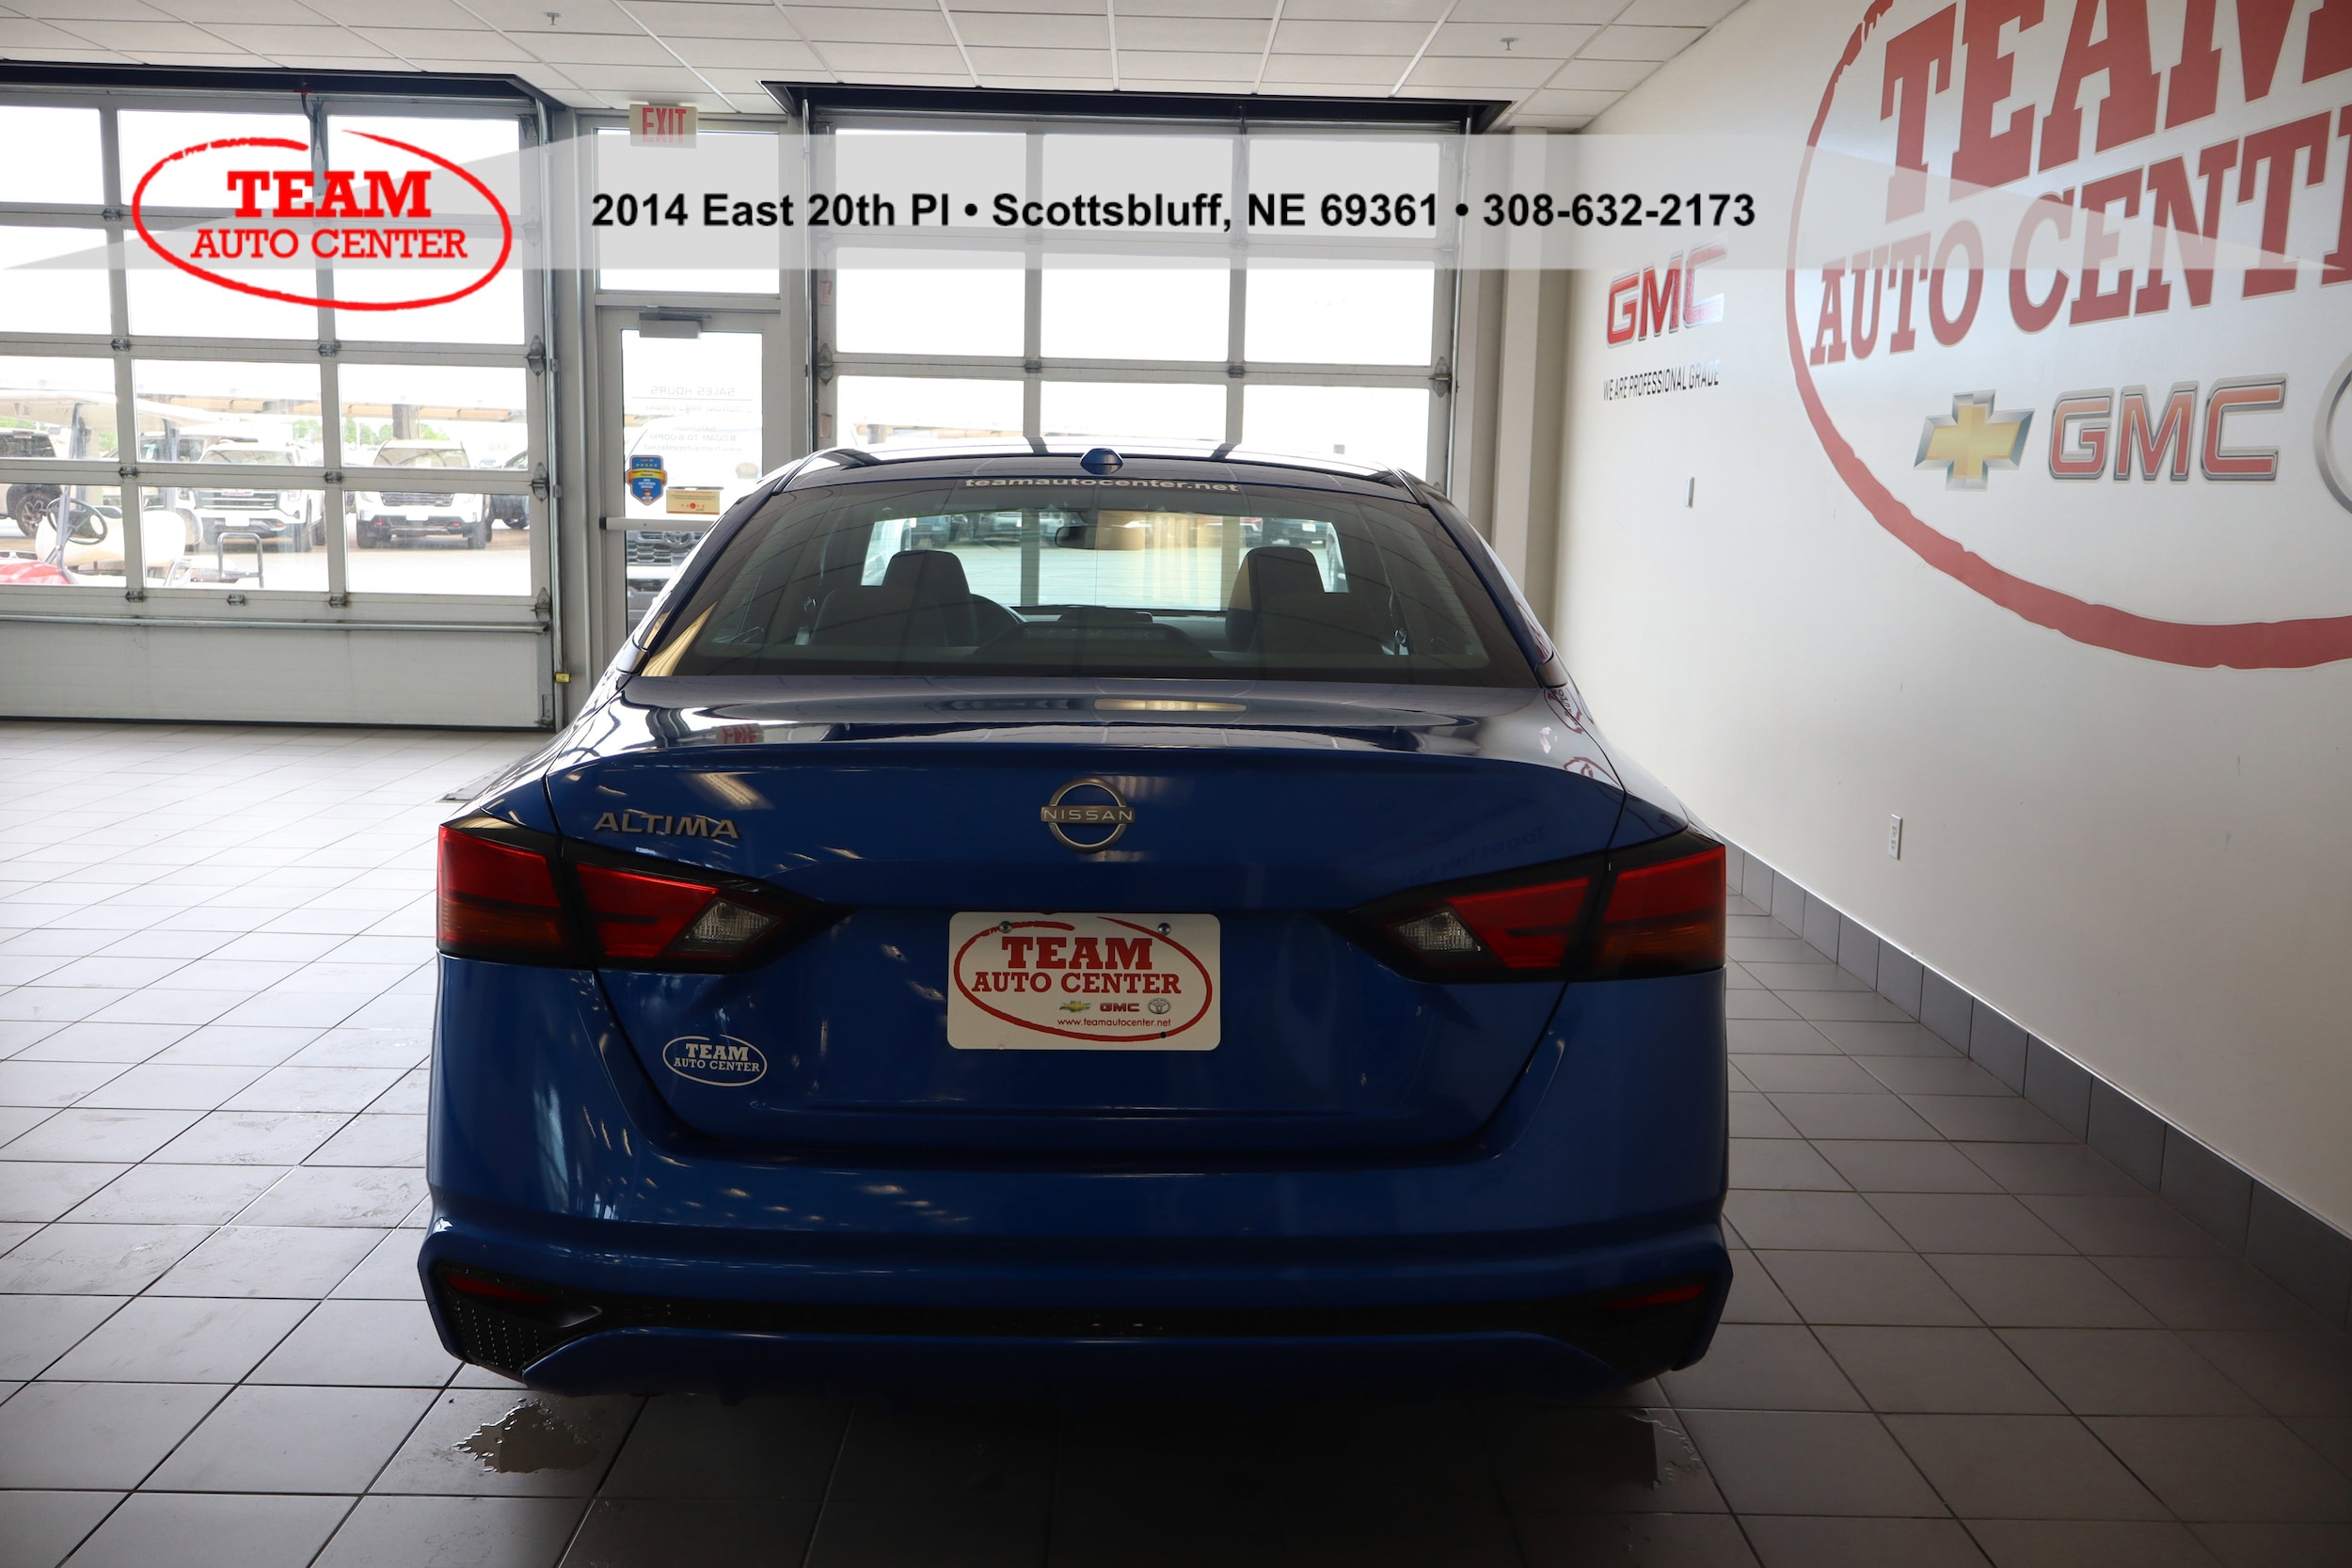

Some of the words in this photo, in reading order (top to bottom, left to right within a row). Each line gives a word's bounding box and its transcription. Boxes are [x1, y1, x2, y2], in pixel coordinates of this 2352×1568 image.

[642, 106, 688, 144] EXIT
[1607, 235, 1727, 349] GMC
[1809, 218, 1984, 366] AUTO
[1603, 378, 1613, 402] WE
[1614, 376, 1629, 399] ARE
[1629, 366, 1687, 398] PROFESSIONAL
[1689, 359, 1721, 389] GRADE
[2049, 373, 2288, 483] GMC
[964, 478, 1239, 493] teamautocenter.net
[594, 812, 739, 839] ALTIMA
[1043, 808, 1133, 821] NISSAN
[1002, 937, 1152, 970] TEAM
[972, 972, 1052, 992] AUTO
[1060, 973, 1182, 994] CENTER
[1100, 1002, 1140, 1012] GMC
[1057, 1017, 1171, 1027] www.teamautocenter.net
[685, 1043, 749, 1061] TEAM
[674, 1057, 707, 1069] AUTO
[709, 1060, 760, 1072] CENTER
